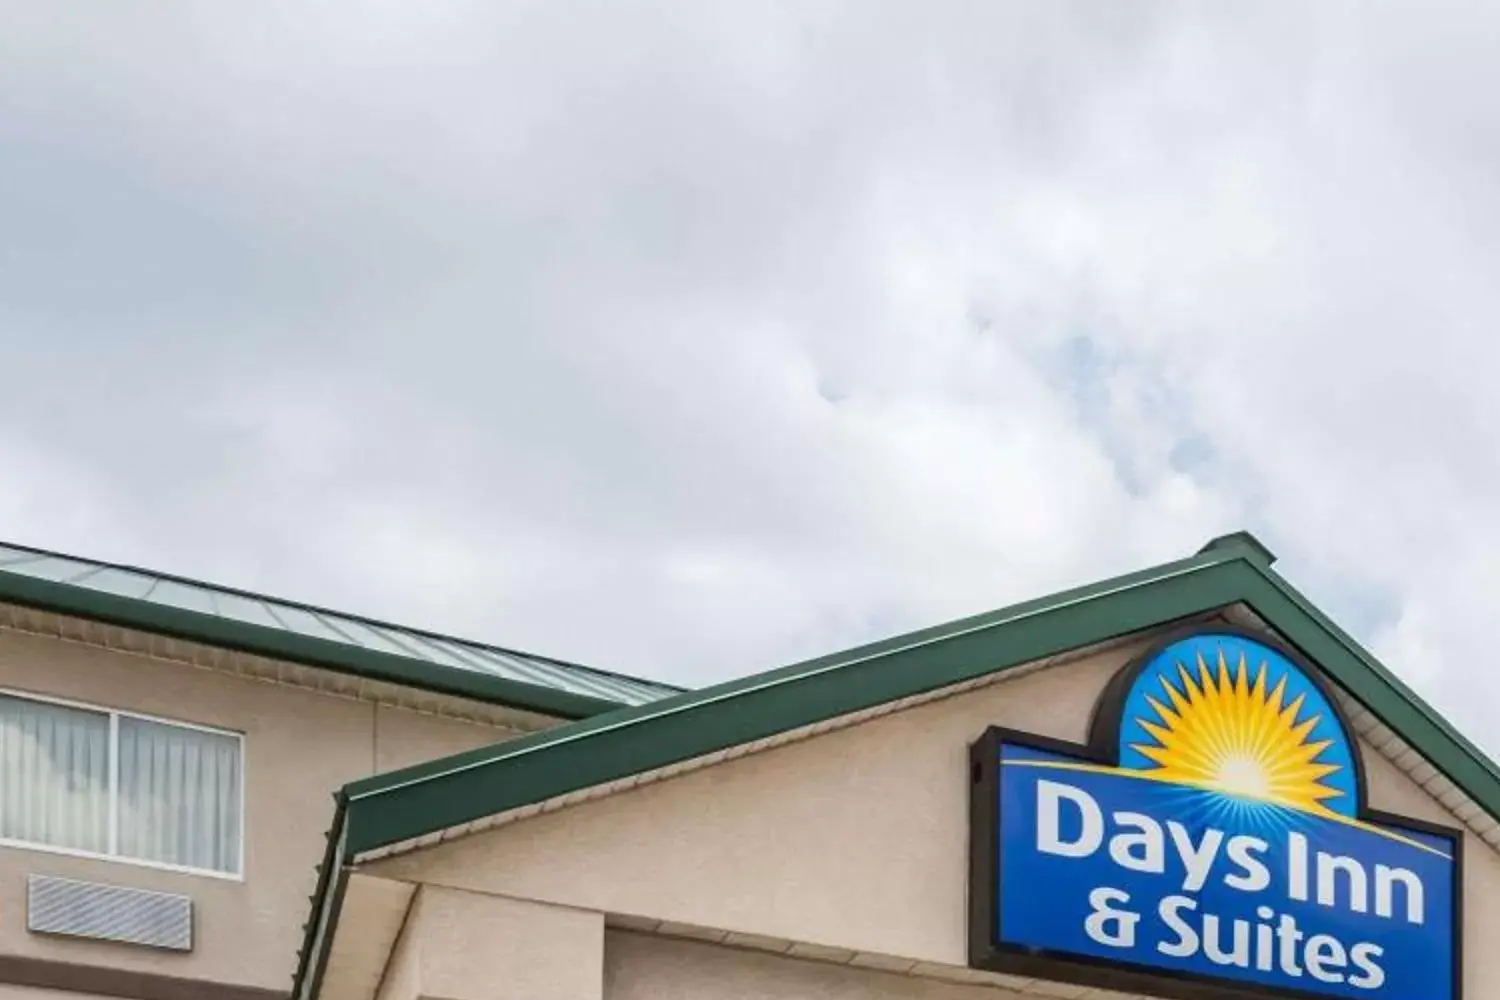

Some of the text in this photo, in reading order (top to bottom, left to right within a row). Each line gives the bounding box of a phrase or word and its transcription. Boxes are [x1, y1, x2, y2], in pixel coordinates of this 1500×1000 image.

[1037, 779, 1424, 924] Days Inn
[1085, 887, 1386, 989] & Suites
